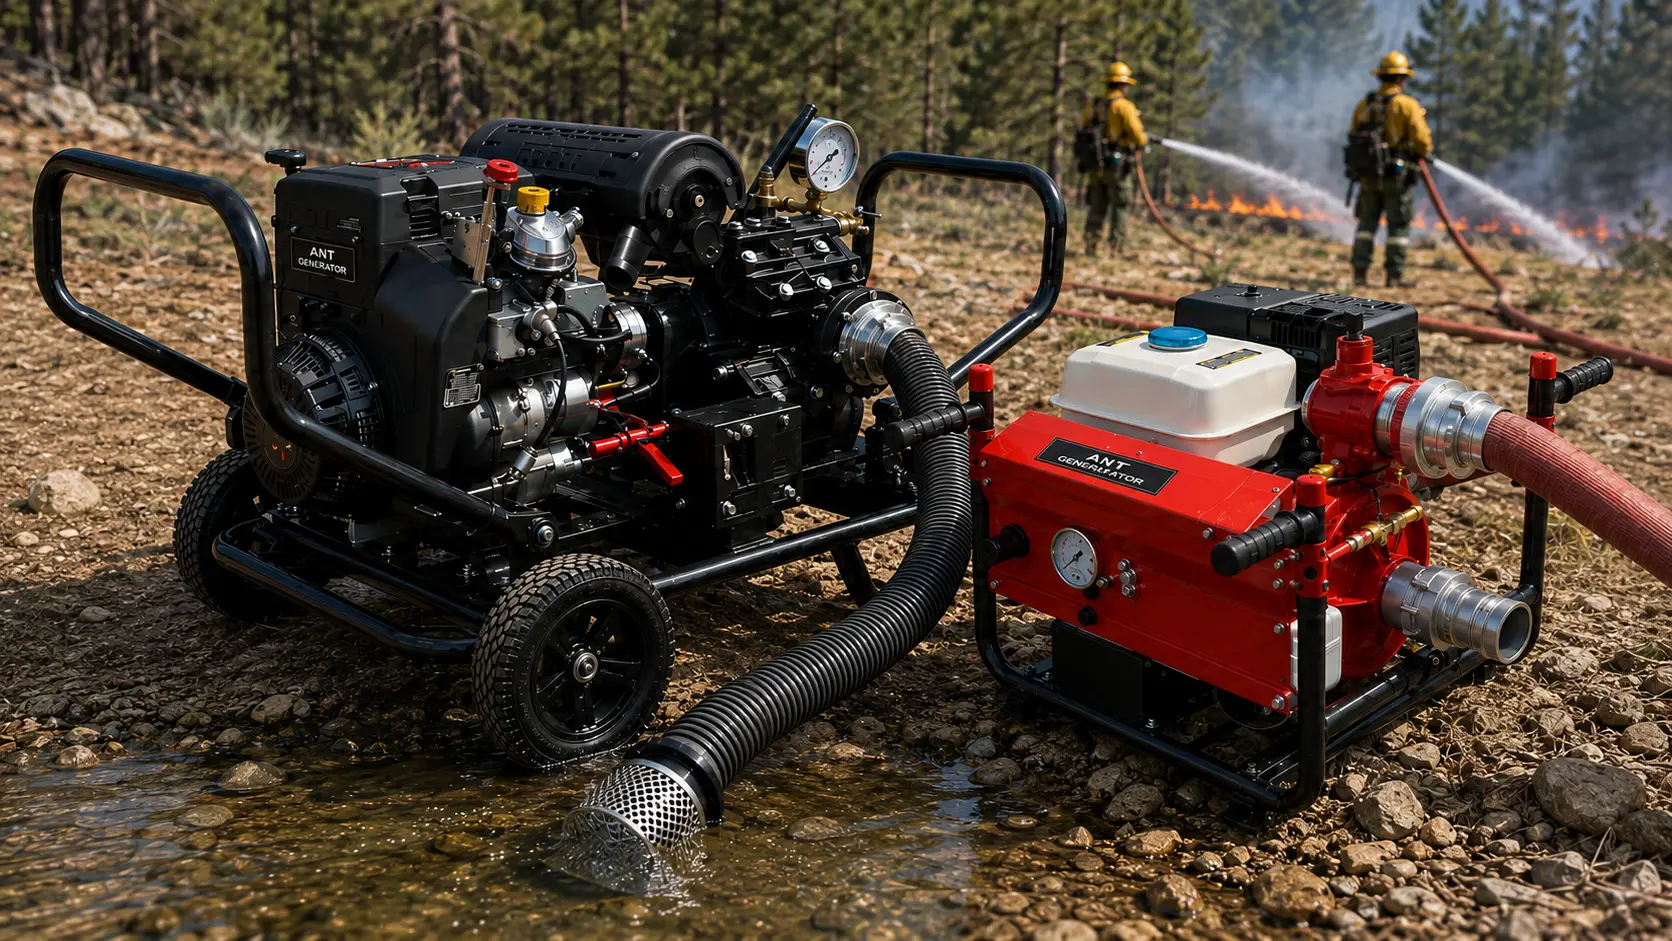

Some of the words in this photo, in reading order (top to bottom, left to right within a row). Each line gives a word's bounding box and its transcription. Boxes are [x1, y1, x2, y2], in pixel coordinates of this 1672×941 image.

[309, 246, 335, 261] ANT
[298, 257, 347, 275] GENERATOR
[1086, 454, 1131, 470] ANT
